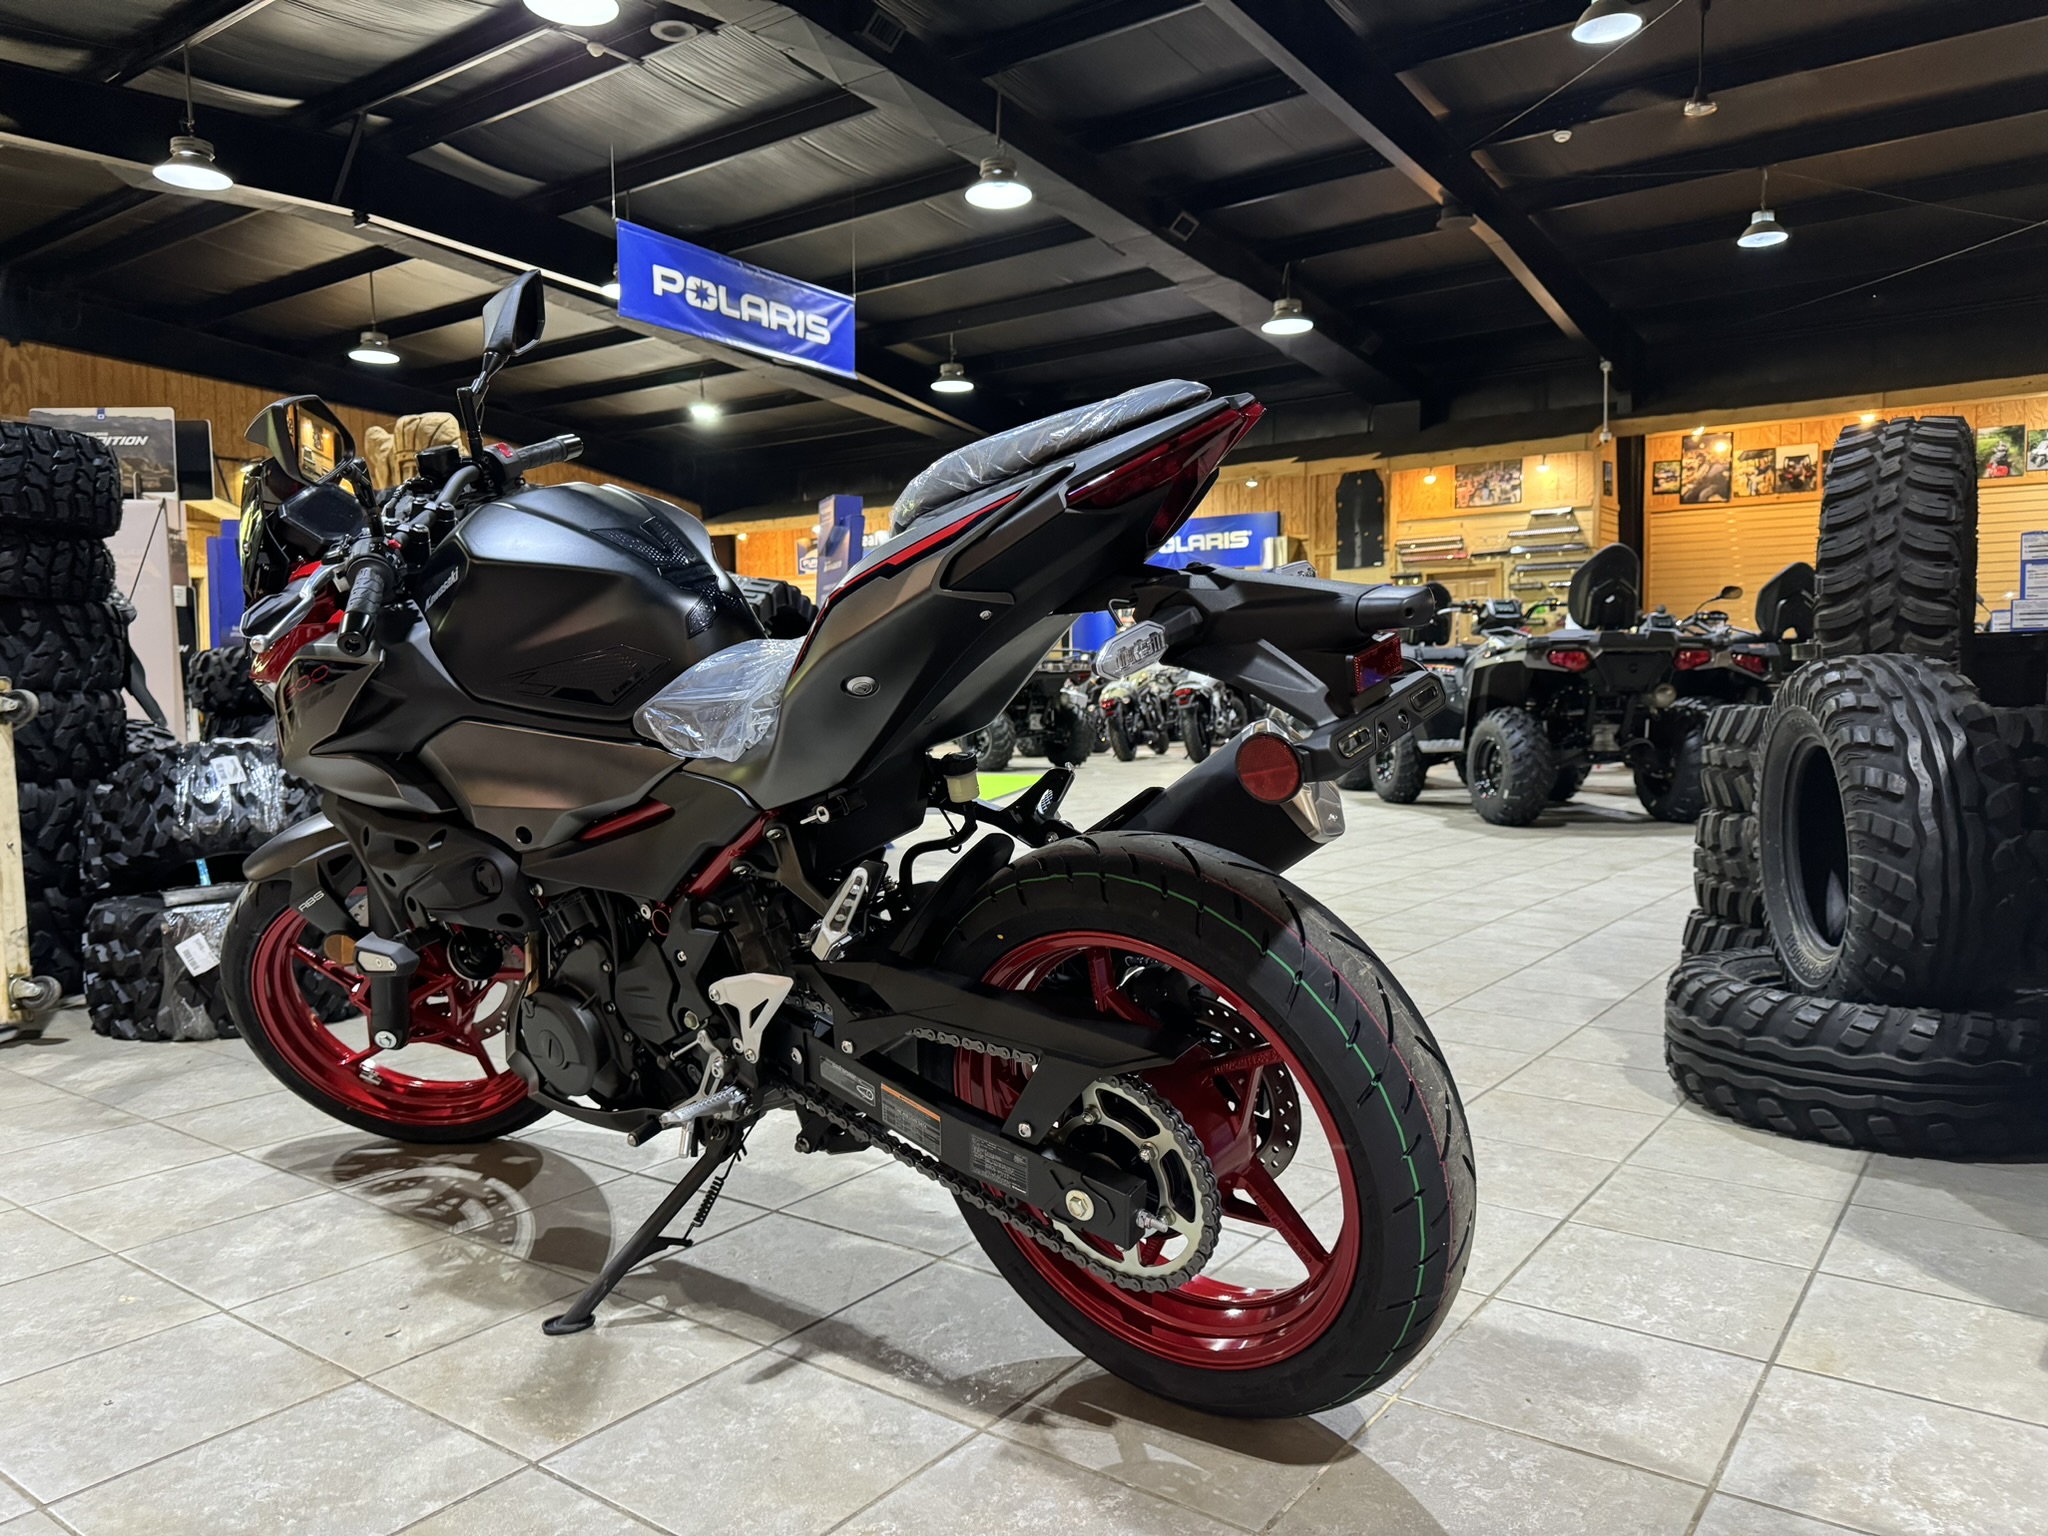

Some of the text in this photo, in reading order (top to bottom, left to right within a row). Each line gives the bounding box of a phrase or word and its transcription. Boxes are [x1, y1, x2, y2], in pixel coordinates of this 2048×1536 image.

[652, 264, 831, 345] POLARIS
[1158, 530, 1250, 554] OLARIS
[298, 890, 325, 912] ABS
